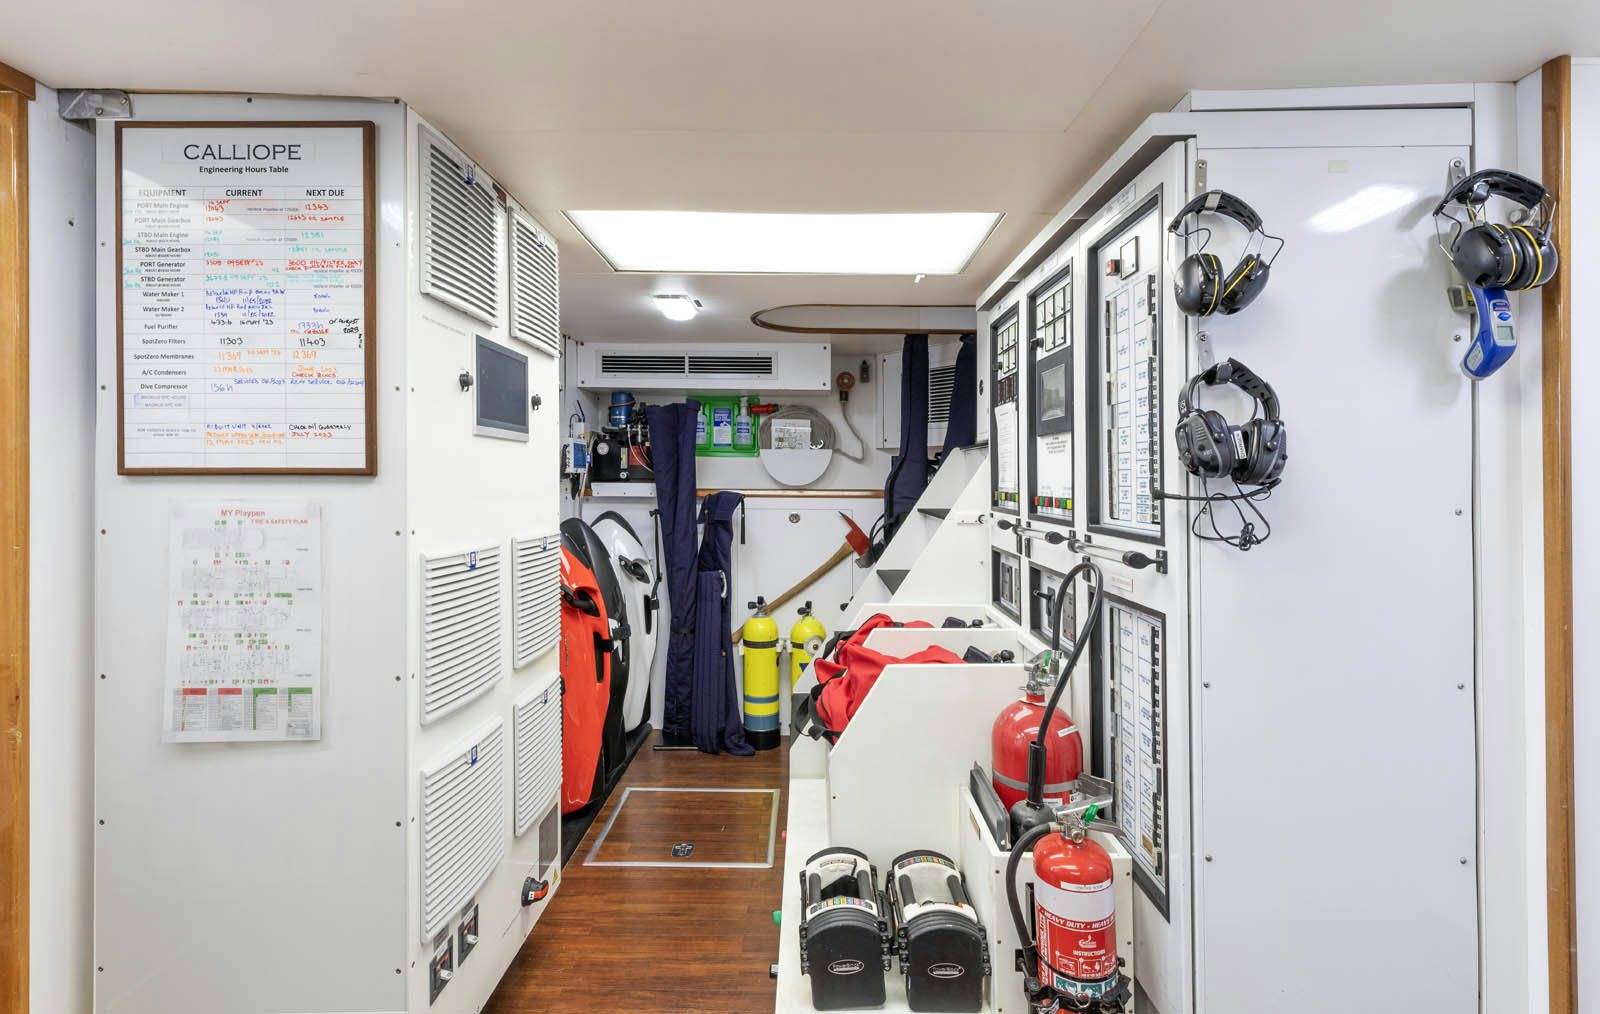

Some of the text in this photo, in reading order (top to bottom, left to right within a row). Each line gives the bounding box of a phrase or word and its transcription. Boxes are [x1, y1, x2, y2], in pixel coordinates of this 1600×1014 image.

[184, 144, 302, 160] CALLIOPE
[200, 166, 243, 174] Engineering
[300, 337, 326, 347] 11403
[235, 510, 265, 518] Playpen
[1044, 911, 1065, 924] HEAVY
